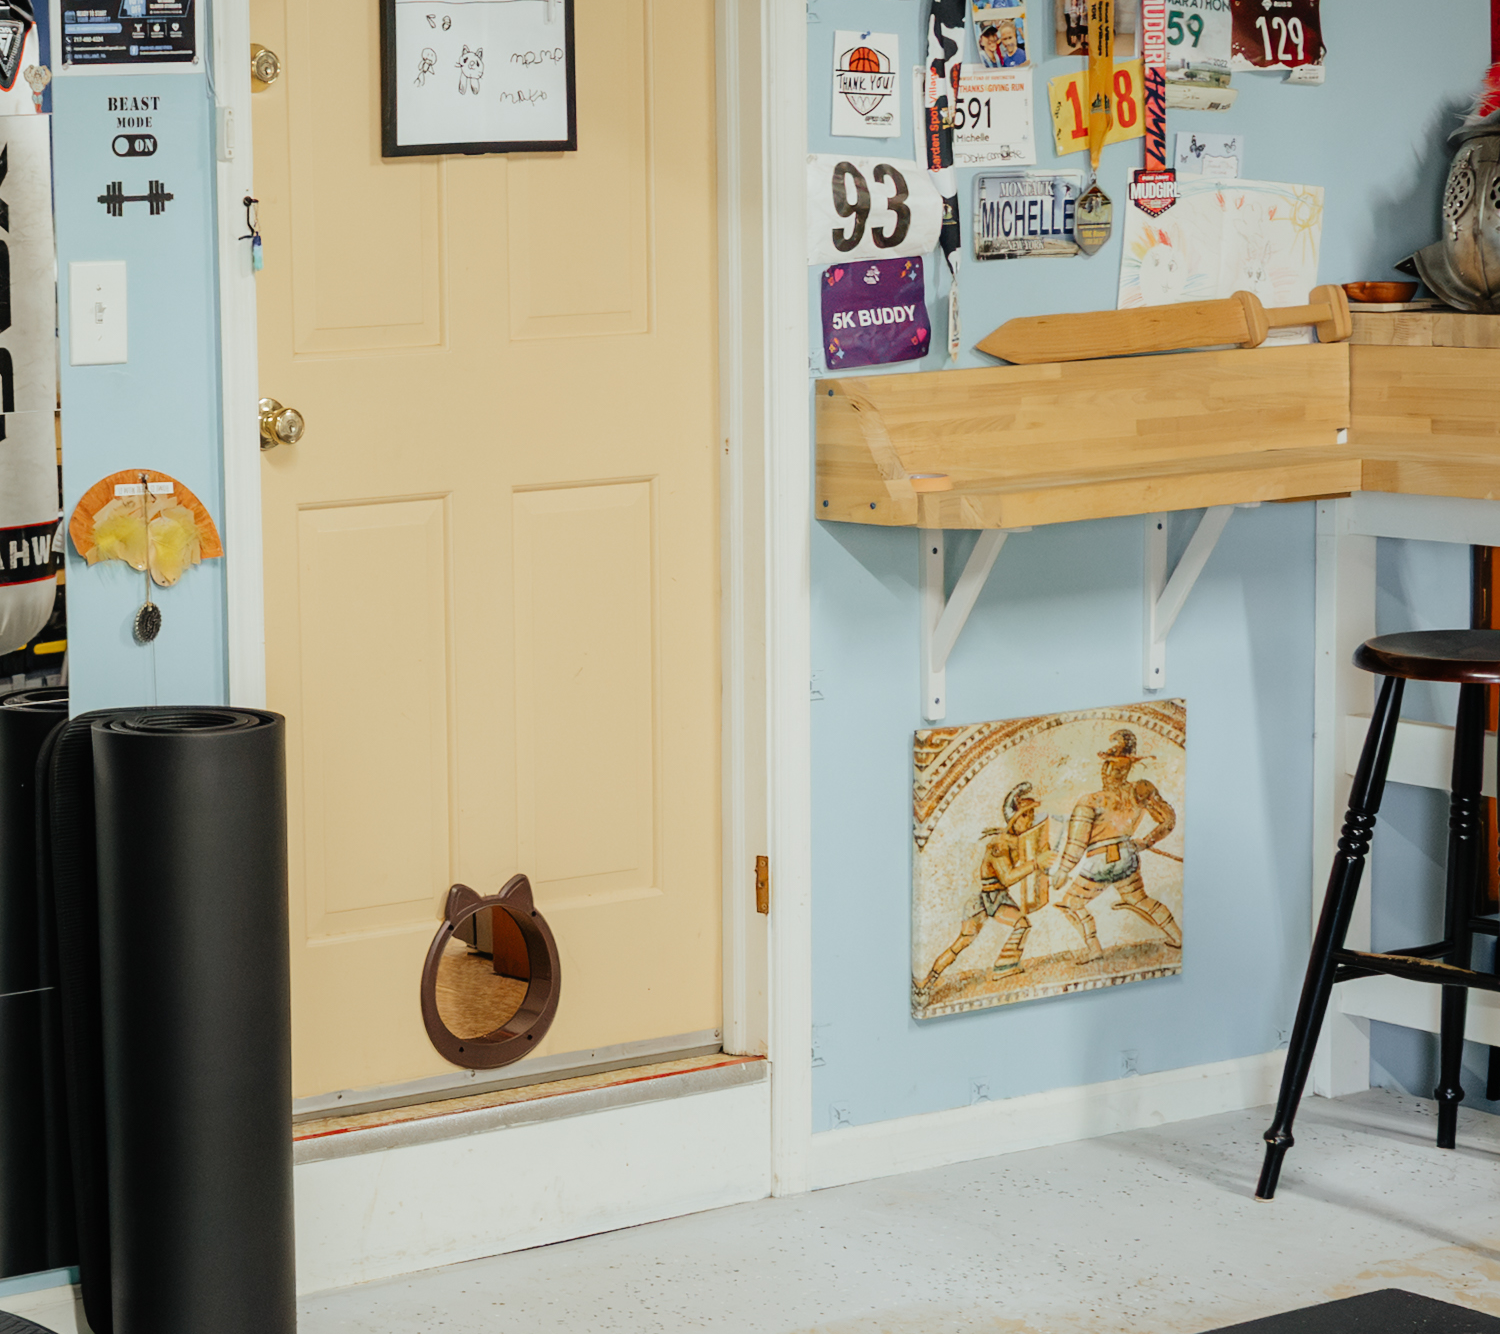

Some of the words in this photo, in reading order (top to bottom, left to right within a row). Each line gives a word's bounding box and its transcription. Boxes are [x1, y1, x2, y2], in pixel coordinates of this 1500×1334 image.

[1256, 16, 1306, 61] 129
[837, 72, 867, 91] THANK
[870, 74, 895, 93] YOU!
[928, 66, 938, 104] Village
[1011, 83, 1025, 91] RUN
[107, 96, 161, 112] BEAST
[954, 97, 991, 130] 591
[1065, 69, 1138, 138] 18
[116, 116, 153, 129] MODE
[929, 106, 942, 132] Spot
[134, 138, 156, 154] ON
[956, 133, 990, 143] Michelle
[929, 133, 942, 173] Garden
[1000, 181, 1055, 198] MONTAUK
[1130, 181, 1182, 200] MUDGIRL
[831, 161, 912, 252] 93
[982, 198, 1075, 239] MICHELLE
[832, 312, 857, 330] 5K
[858, 304, 917, 327] BUDDY
